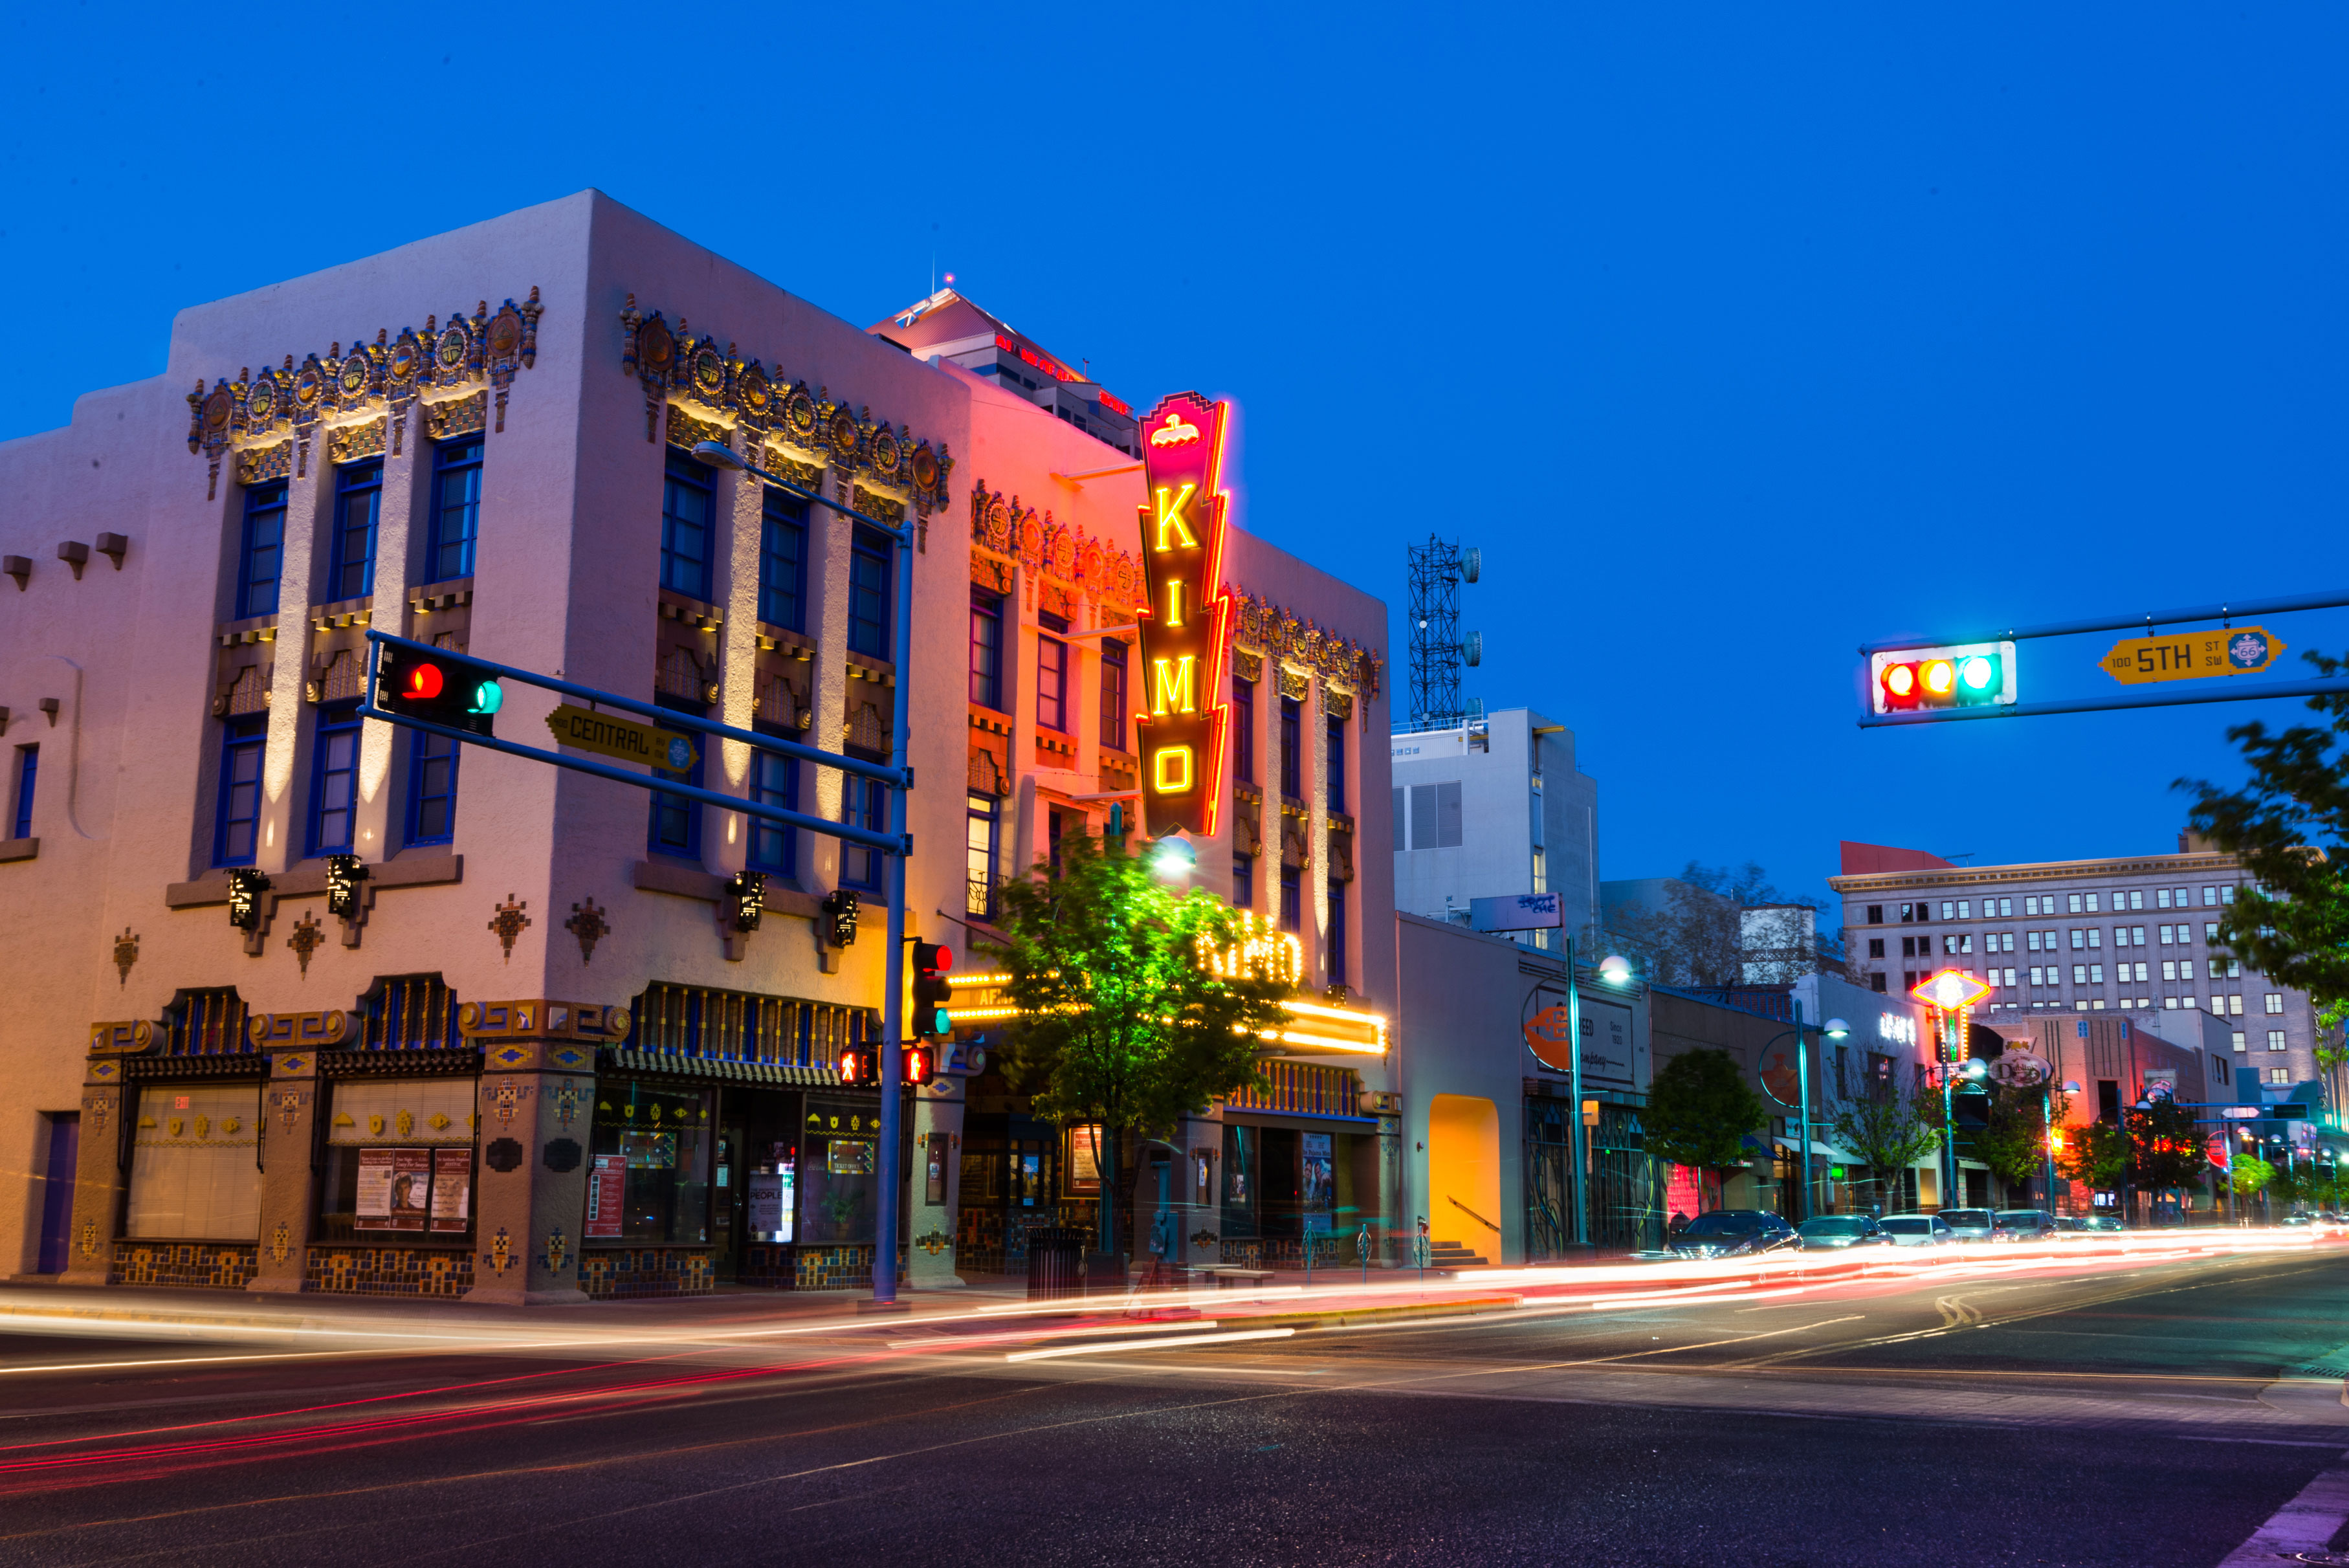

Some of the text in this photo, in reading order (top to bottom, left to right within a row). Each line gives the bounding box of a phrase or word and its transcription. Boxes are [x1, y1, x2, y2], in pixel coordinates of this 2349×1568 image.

[1152, 483, 1200, 795] KIMO
[2205, 641, 2220, 652] ST
[2240, 646, 2256, 657] 66
[2112, 643, 2192, 672] 100 5TH
[2205, 656, 2222, 667] SW
[569, 715, 650, 755] CENTRAL
[656, 736, 666, 747] AV
[1610, 1021, 1622, 1033] Since
[1612, 1035, 1623, 1045] 1920
[175, 1096, 190, 1109] EXIT
